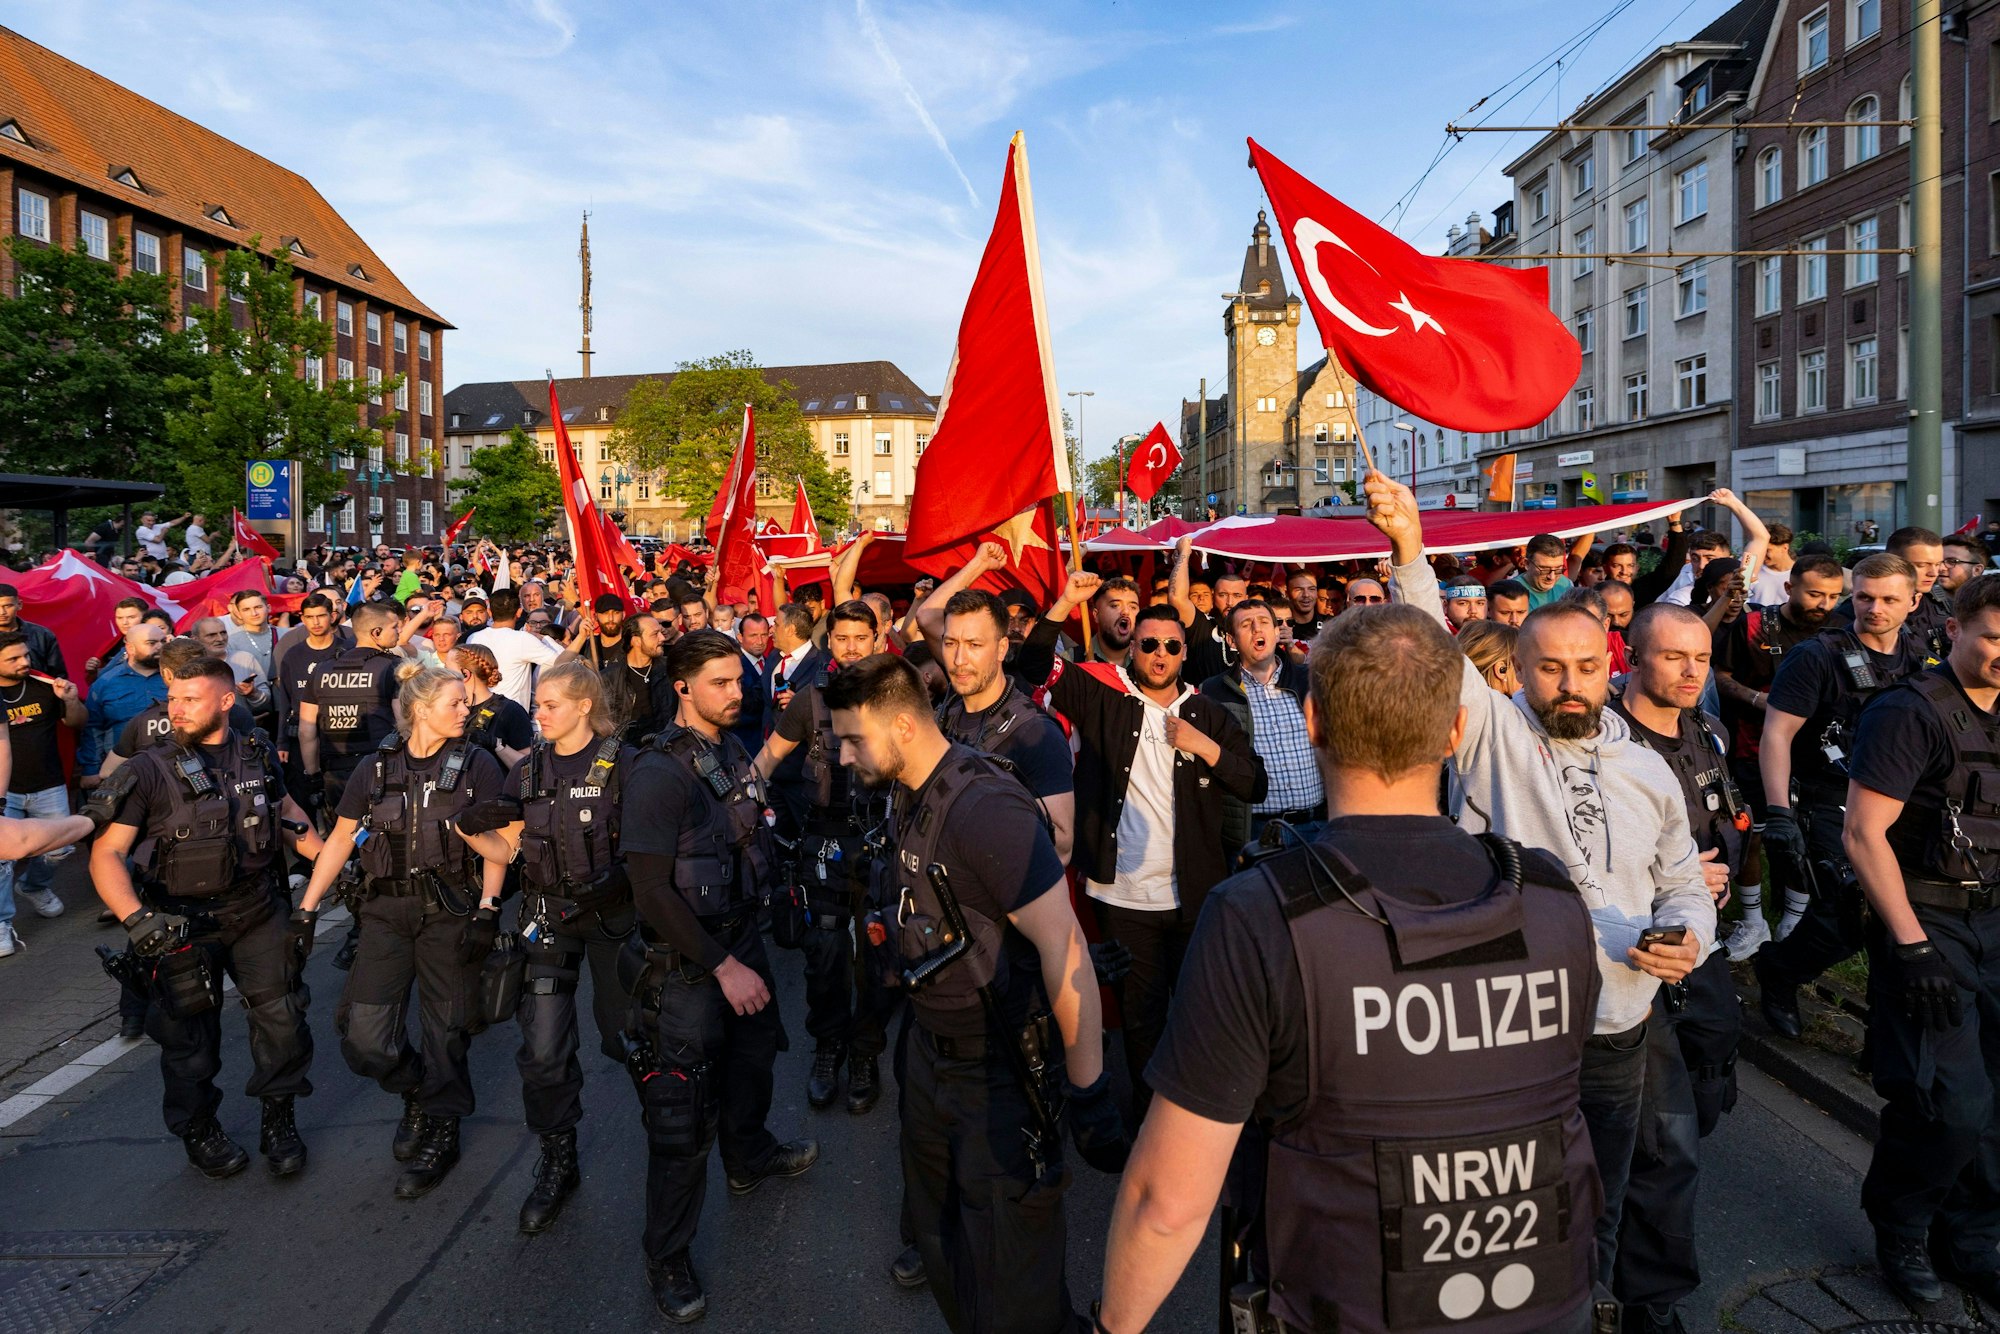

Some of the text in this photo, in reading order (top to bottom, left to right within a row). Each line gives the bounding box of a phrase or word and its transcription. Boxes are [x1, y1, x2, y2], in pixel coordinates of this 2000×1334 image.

[256, 469, 266, 480] H
[280, 466, 289, 478] 4
[320, 672, 373, 688] POLIZEI
[328, 704, 359, 717] NRW
[147, 718, 175, 736] PO
[329, 717, 358, 729] 2622
[1694, 767, 1720, 789] POLIZE
[570, 786, 601, 799] POLIZEI
[1352, 968, 1569, 1056] POLIZEI
[1412, 1140, 1537, 1205] NRW
[1422, 1199, 1539, 1263] 2622
